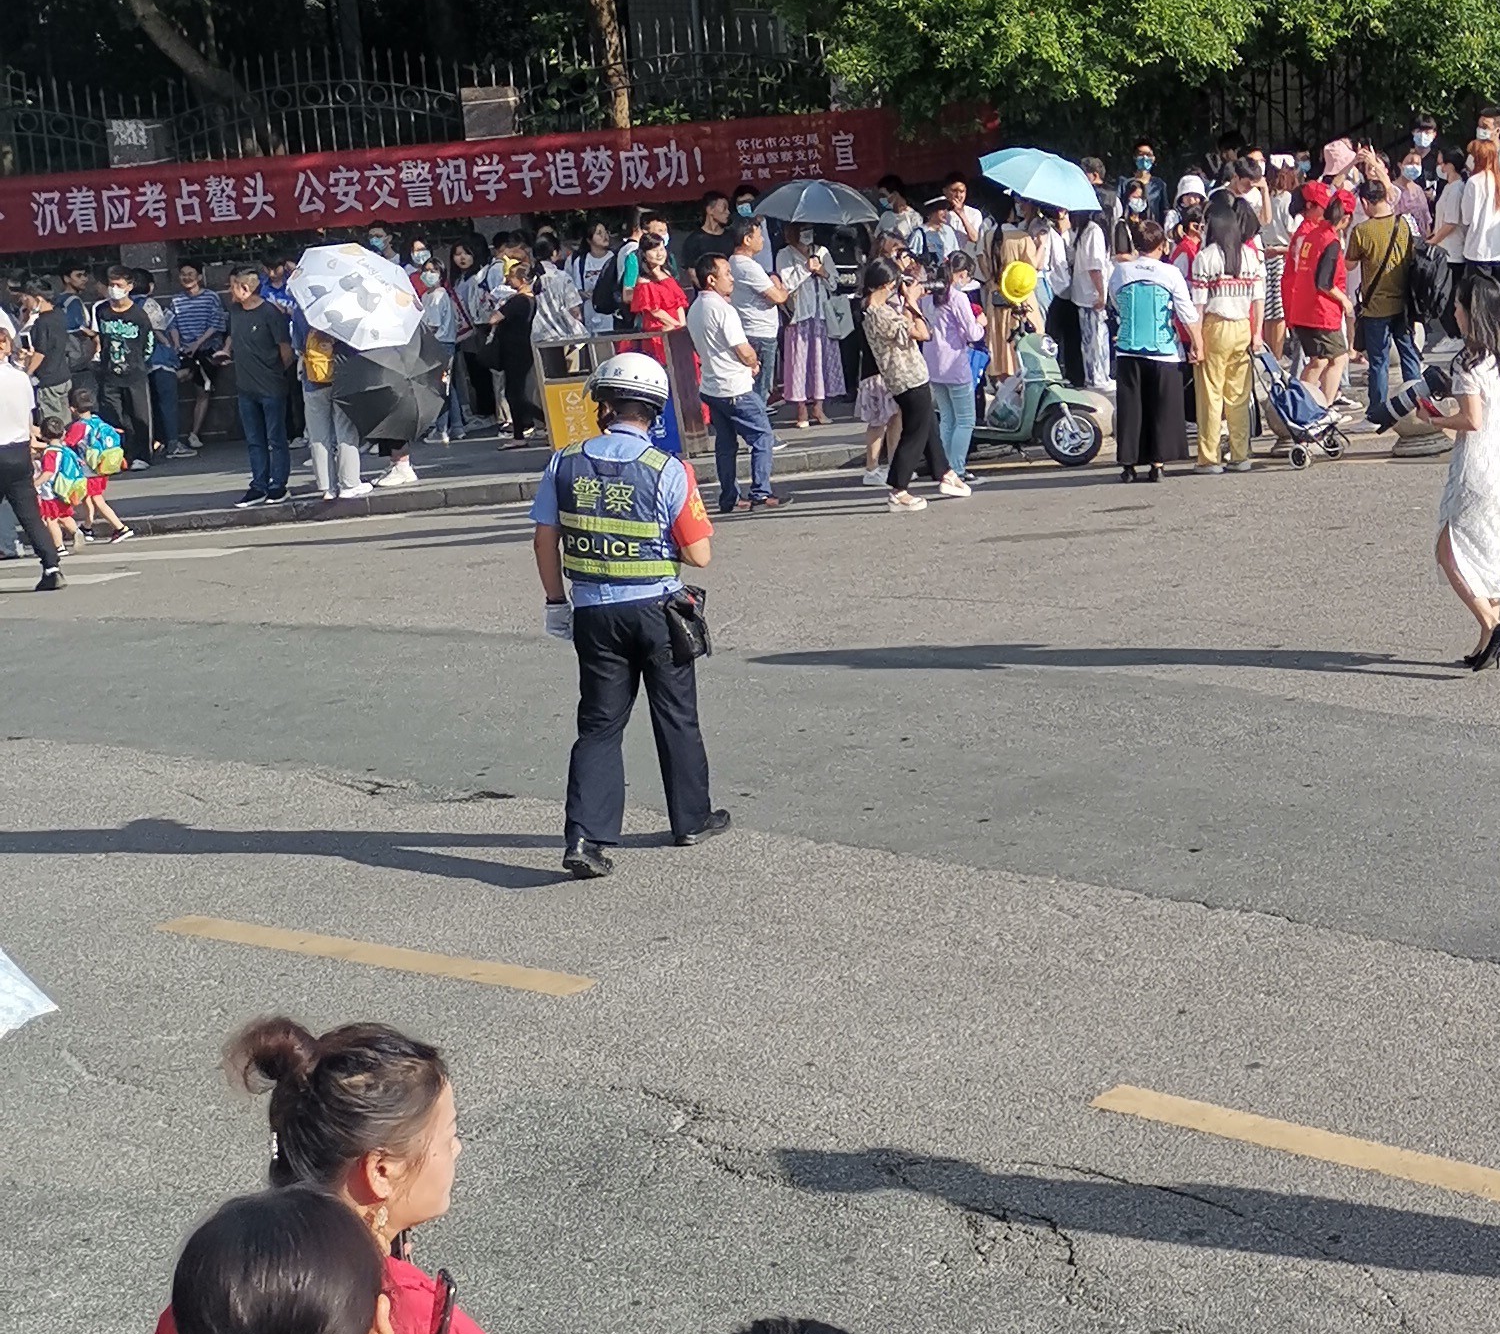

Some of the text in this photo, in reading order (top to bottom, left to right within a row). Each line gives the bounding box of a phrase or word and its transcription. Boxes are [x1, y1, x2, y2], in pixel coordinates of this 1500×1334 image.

[736, 132, 820, 151] 怀化市公安局
[738, 148, 823, 166] 交通警察支队
[831, 130, 858, 171] 宣
[30, 139, 706, 237] 沉着应考占鳌头 公安交警祝学子追梦成功！
[572, 475, 635, 513] 警察
[567, 534, 641, 558] POLICE
